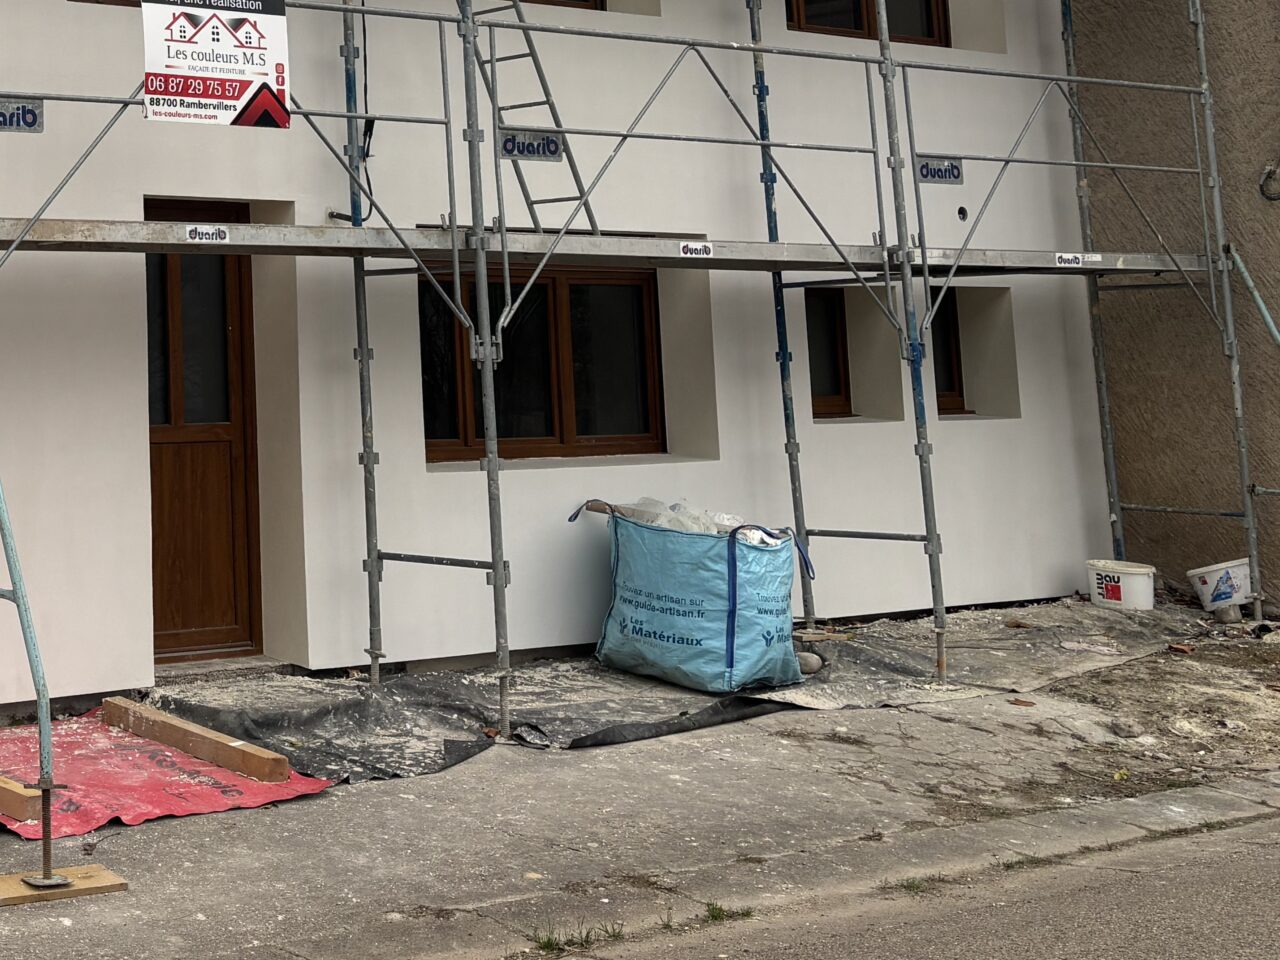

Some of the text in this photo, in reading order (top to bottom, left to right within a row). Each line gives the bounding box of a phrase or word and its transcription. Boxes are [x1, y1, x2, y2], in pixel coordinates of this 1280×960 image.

[167, 45, 266, 66] Les couleurs M.S
[148, 75, 240, 97] 06 87 29 75 57
[149, 97, 238, 112] 88700 Rambervillers
[152, 109, 218, 120] les-couleurs-ms.com
[503, 133, 559, 155] duarib
[920, 162, 960, 179] duarib
[188, 227, 226, 240] duarib
[682, 245, 711, 255] duarib
[1058, 255, 1080, 264] duarib
[644, 591, 654, 599] un
[656, 593, 686, 606] artisan
[689, 598, 705, 607] sur
[630, 616, 644, 626] Les
[631, 626, 704, 646] Matériaux
